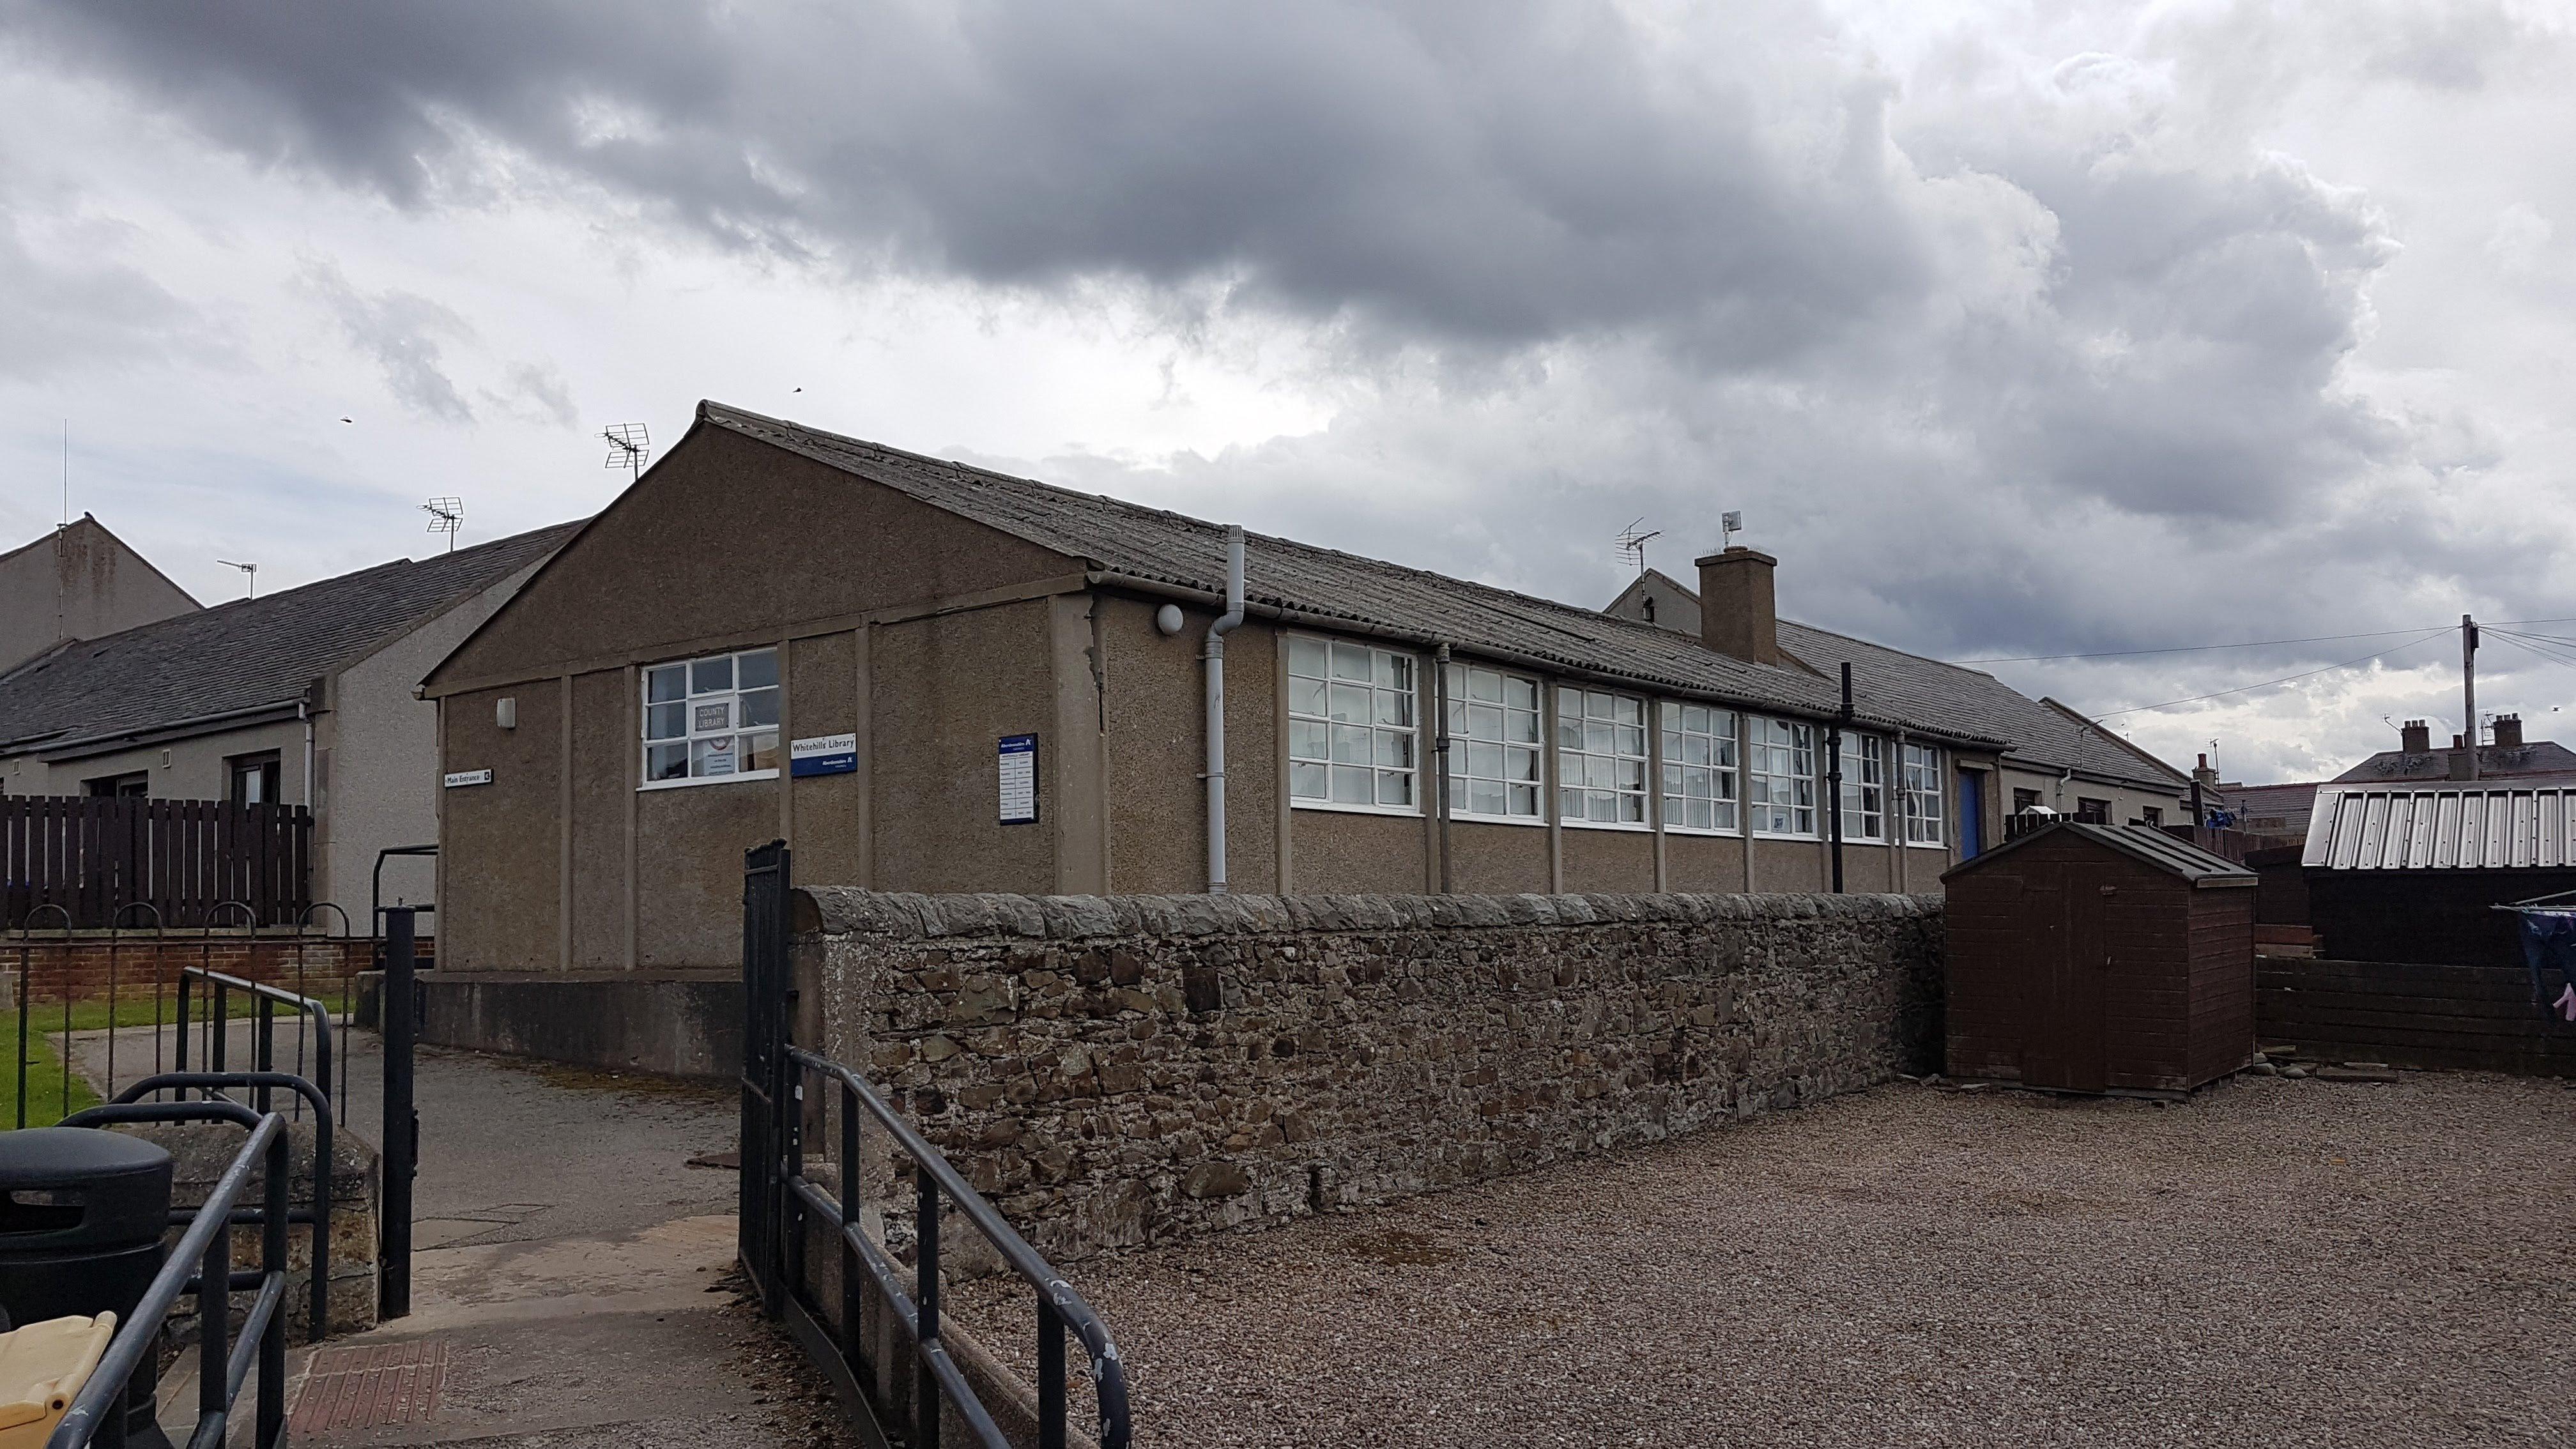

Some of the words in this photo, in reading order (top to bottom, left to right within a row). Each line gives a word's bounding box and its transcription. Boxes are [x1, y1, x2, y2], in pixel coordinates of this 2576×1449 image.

[700, 707, 725, 717] COUNTY
[698, 717, 725, 728] LIBRARY
[793, 742, 826, 752] Whitehills
[829, 740, 854, 748] Library
